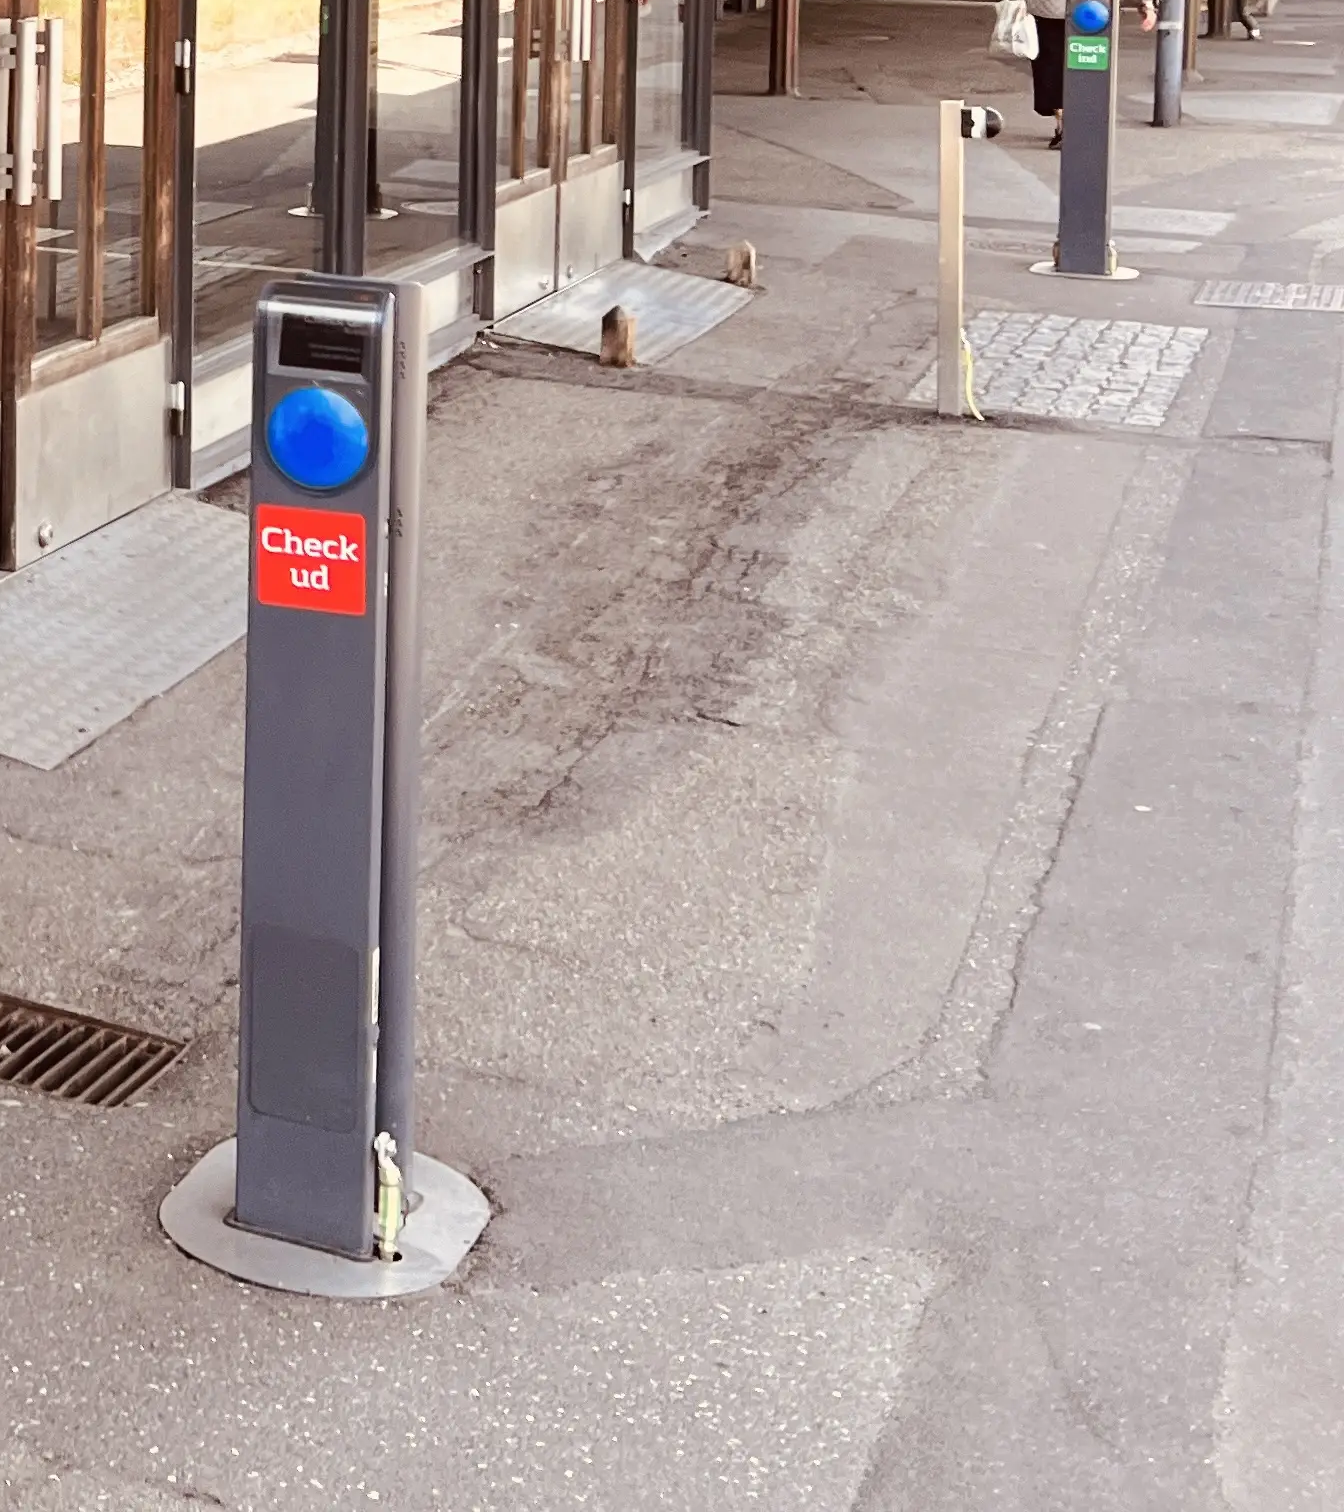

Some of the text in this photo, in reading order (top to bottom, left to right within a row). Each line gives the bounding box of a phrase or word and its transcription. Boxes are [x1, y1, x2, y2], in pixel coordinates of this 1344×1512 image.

[1069, 42, 1107, 54] Check
[1077, 53, 1098, 64] ind
[261, 526, 360, 563] Check
[289, 564, 331, 592] ud
